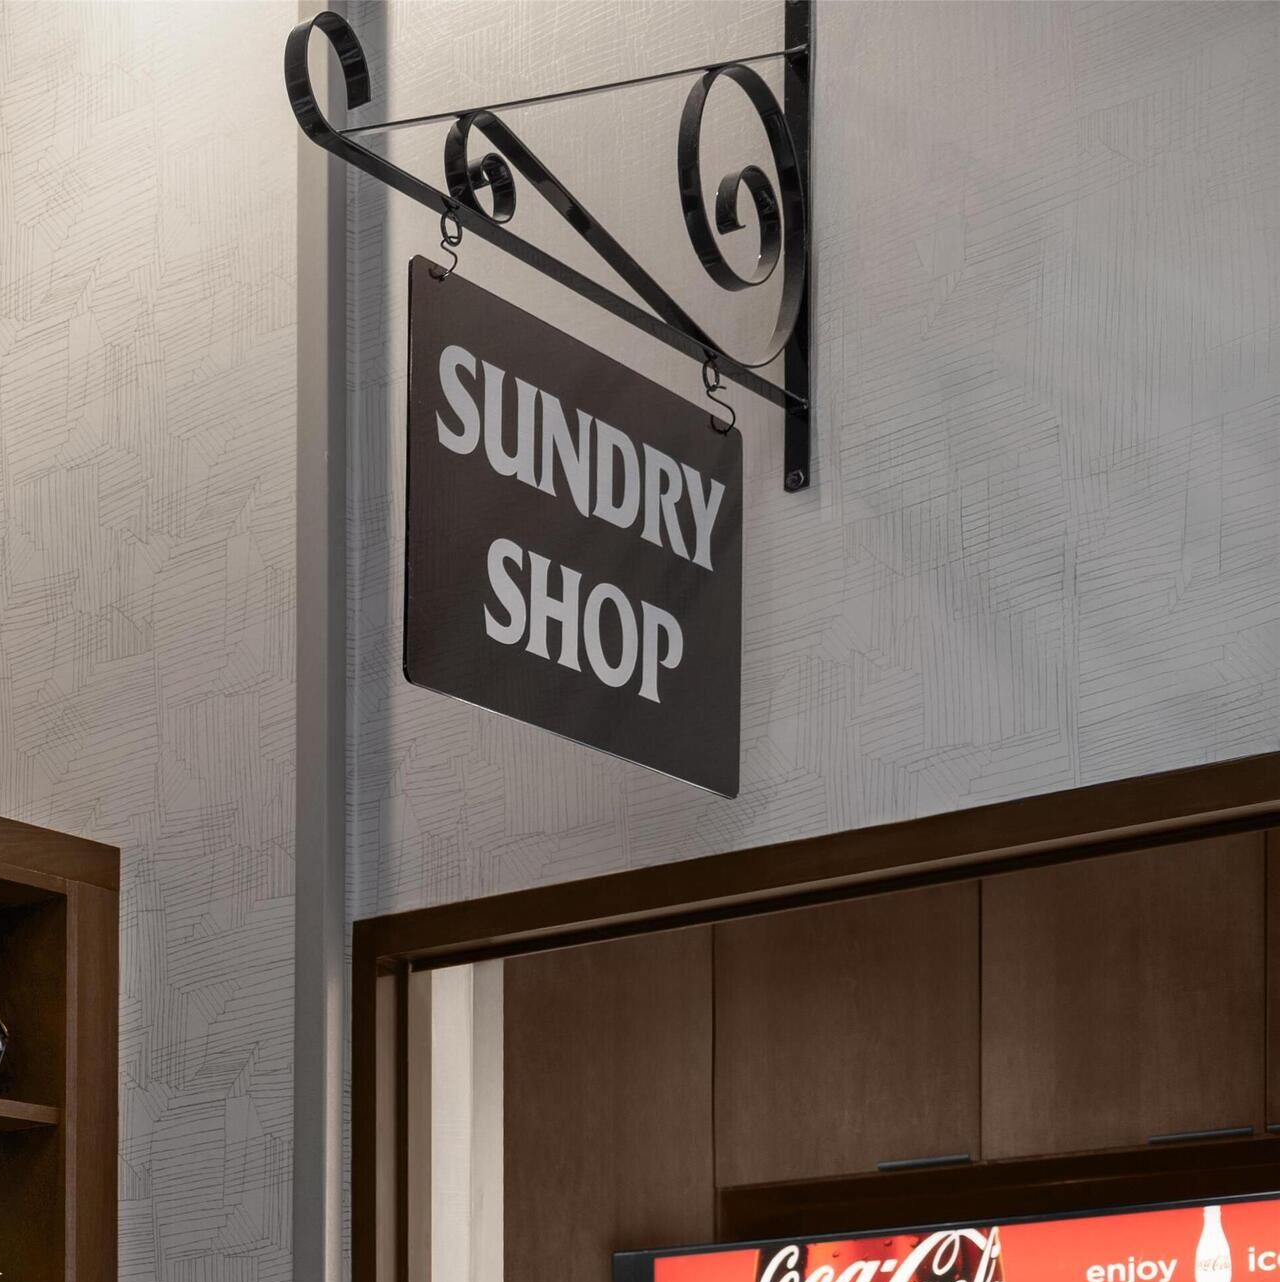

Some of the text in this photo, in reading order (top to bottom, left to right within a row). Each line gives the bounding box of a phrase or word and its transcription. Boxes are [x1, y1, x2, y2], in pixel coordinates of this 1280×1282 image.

[436, 345, 726, 572] SUNDRY
[484, 537, 684, 704] SHOP
[1248, 1246, 1280, 1272] ic
